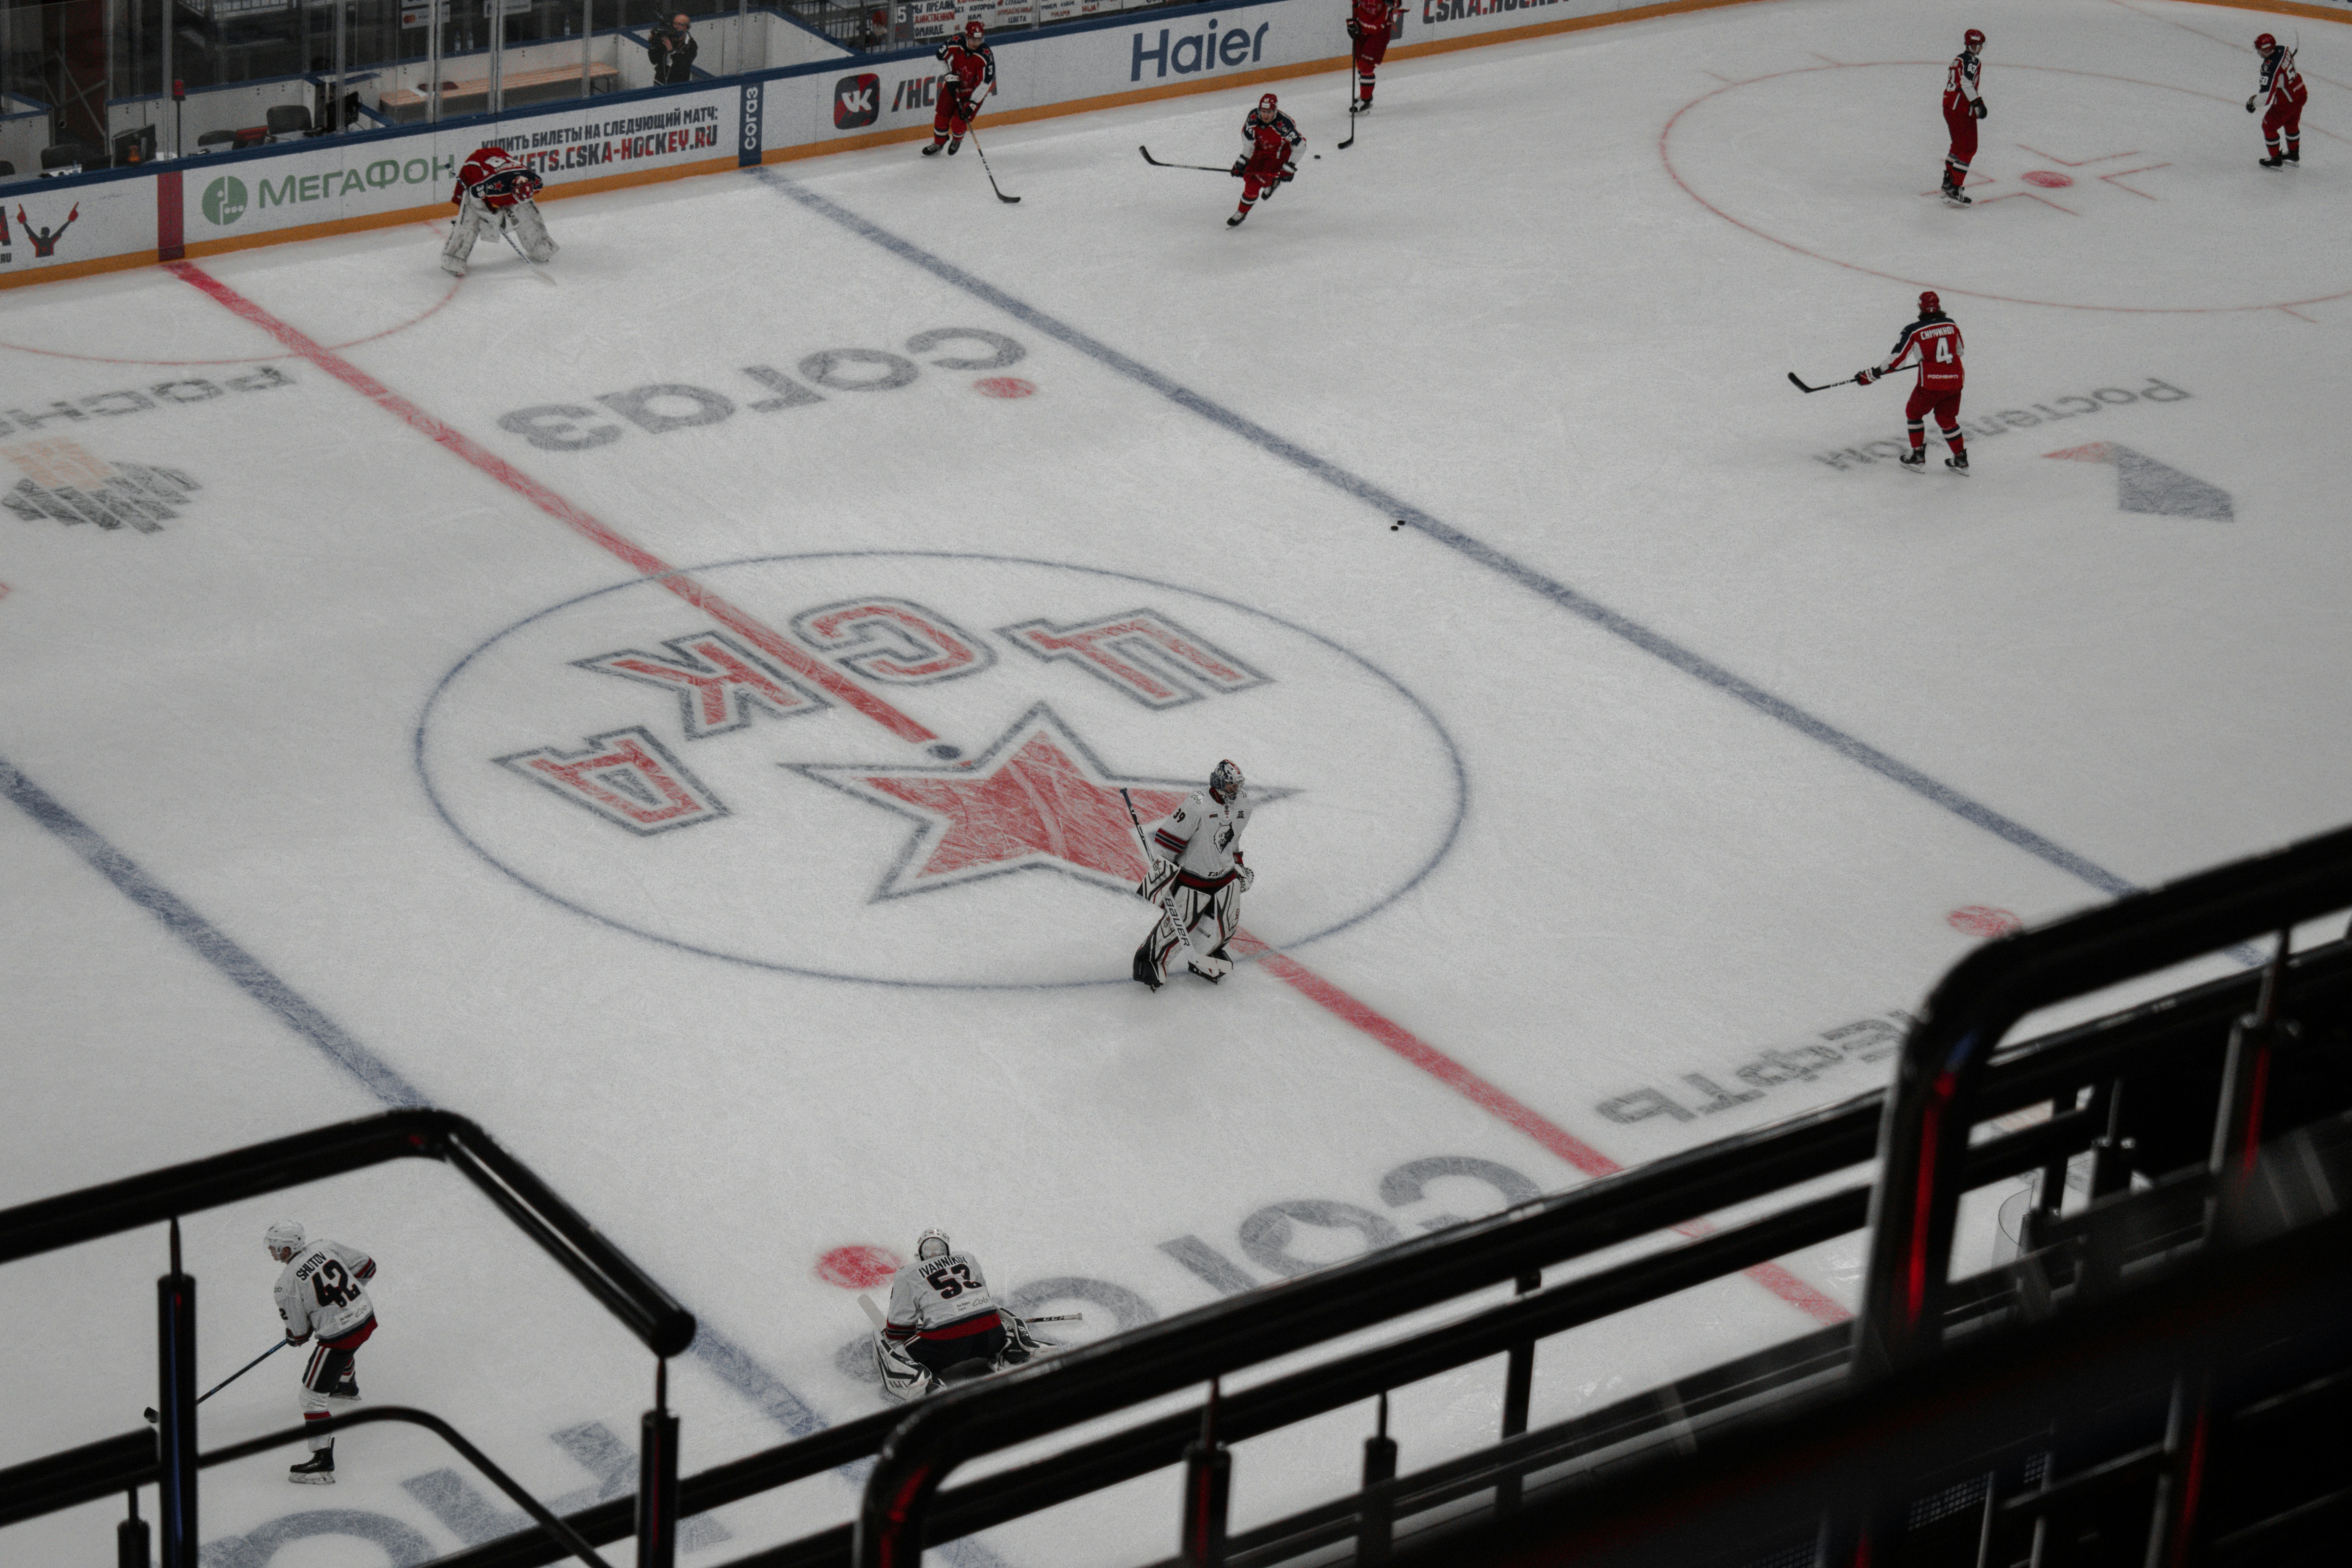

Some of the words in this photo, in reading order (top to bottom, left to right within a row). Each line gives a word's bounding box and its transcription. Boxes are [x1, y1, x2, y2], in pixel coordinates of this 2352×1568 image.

[970, 2, 996, 11] КОТОРОЙ
[1131, 18, 1269, 82] Haier
[841, 88, 873, 113] VK
[532, 128, 582, 148] БИЛЕТЫ
[585, 123, 600, 140] НА
[604, 107, 681, 137] СЛЕДУЮЩИЙ
[683, 106, 718, 127] МАТЧ:
[259, 154, 455, 208] МЕГАФОН
[1935, 336, 1954, 364] 4
[1173, 808, 1186, 823] 39
[296, 1251, 327, 1281] SHUTOV
[312, 1259, 361, 1308] 42
